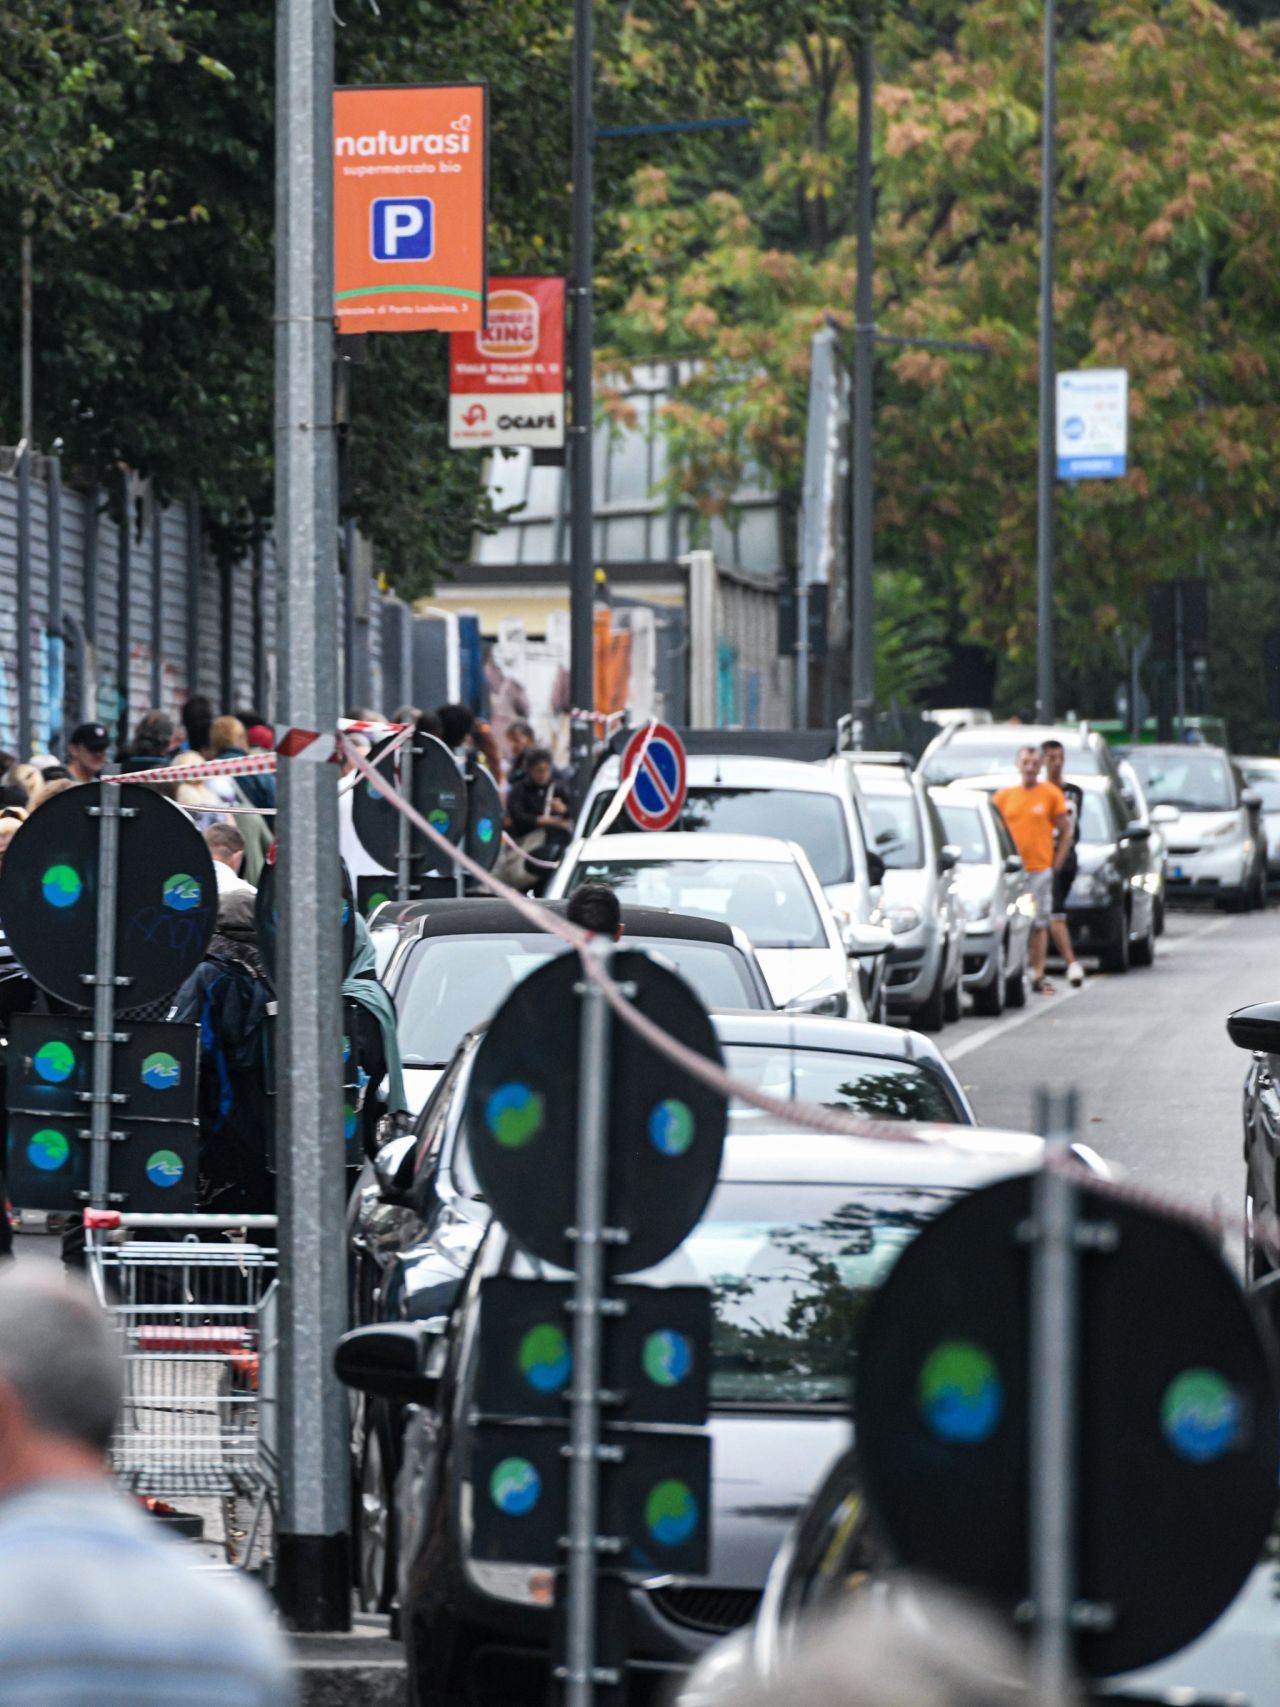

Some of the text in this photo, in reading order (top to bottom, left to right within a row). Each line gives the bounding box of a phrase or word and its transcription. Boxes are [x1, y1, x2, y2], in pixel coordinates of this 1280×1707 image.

[343, 161, 462, 177] supermercato bio
[384, 205, 424, 255] P
[482, 327, 534, 341] KING
